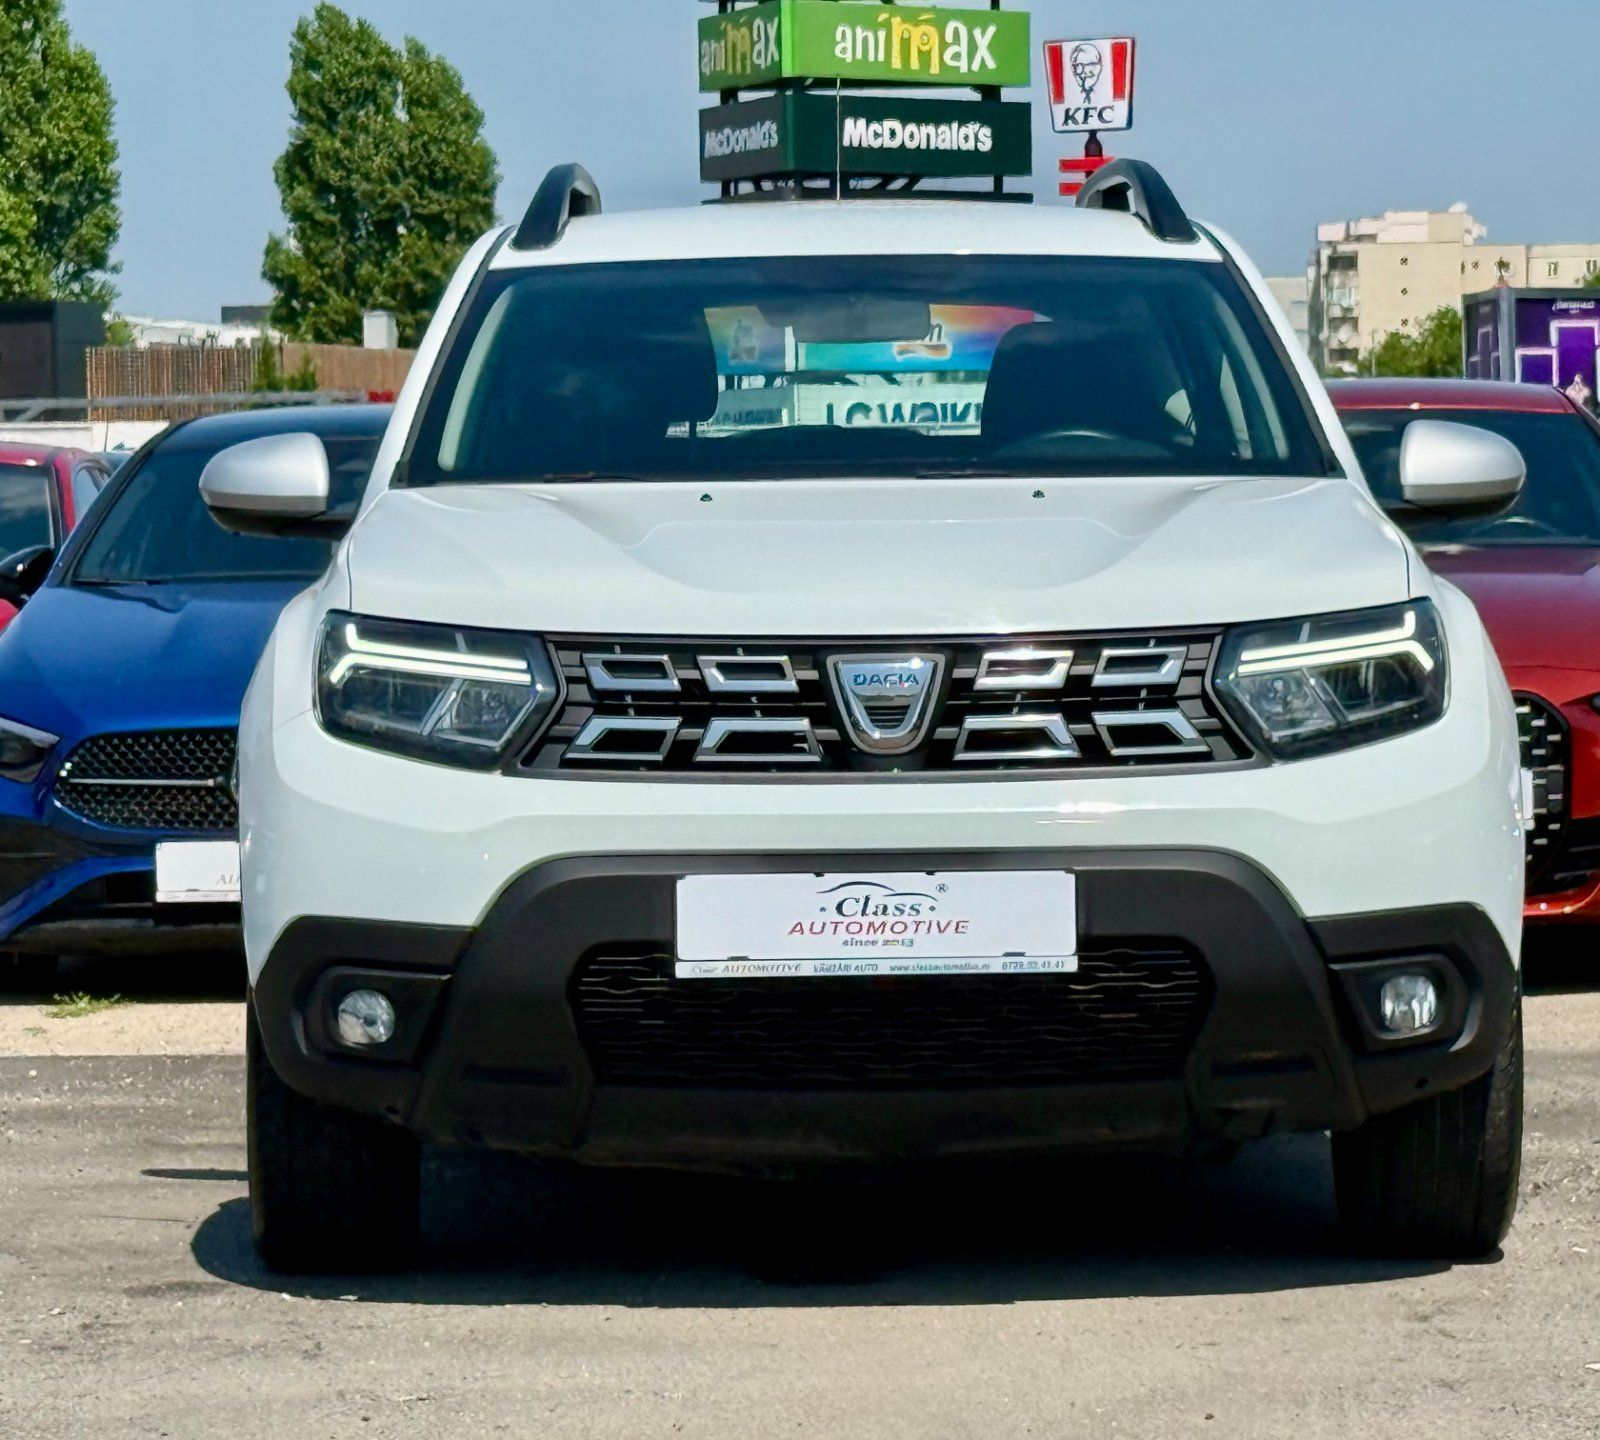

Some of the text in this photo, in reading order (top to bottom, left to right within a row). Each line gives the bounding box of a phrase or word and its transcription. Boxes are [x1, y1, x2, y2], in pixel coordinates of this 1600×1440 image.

[701, 17, 780, 76] animax
[834, 13, 998, 75] animax
[1062, 105, 1115, 127] KFC
[704, 120, 779, 159] McDonald's
[842, 117, 993, 152] McDonald's
[853, 673, 920, 686] DACIA
[835, 894, 922, 917] Class
[788, 919, 970, 936] AUTOMOTIVE
[842, 937, 878, 947] since
